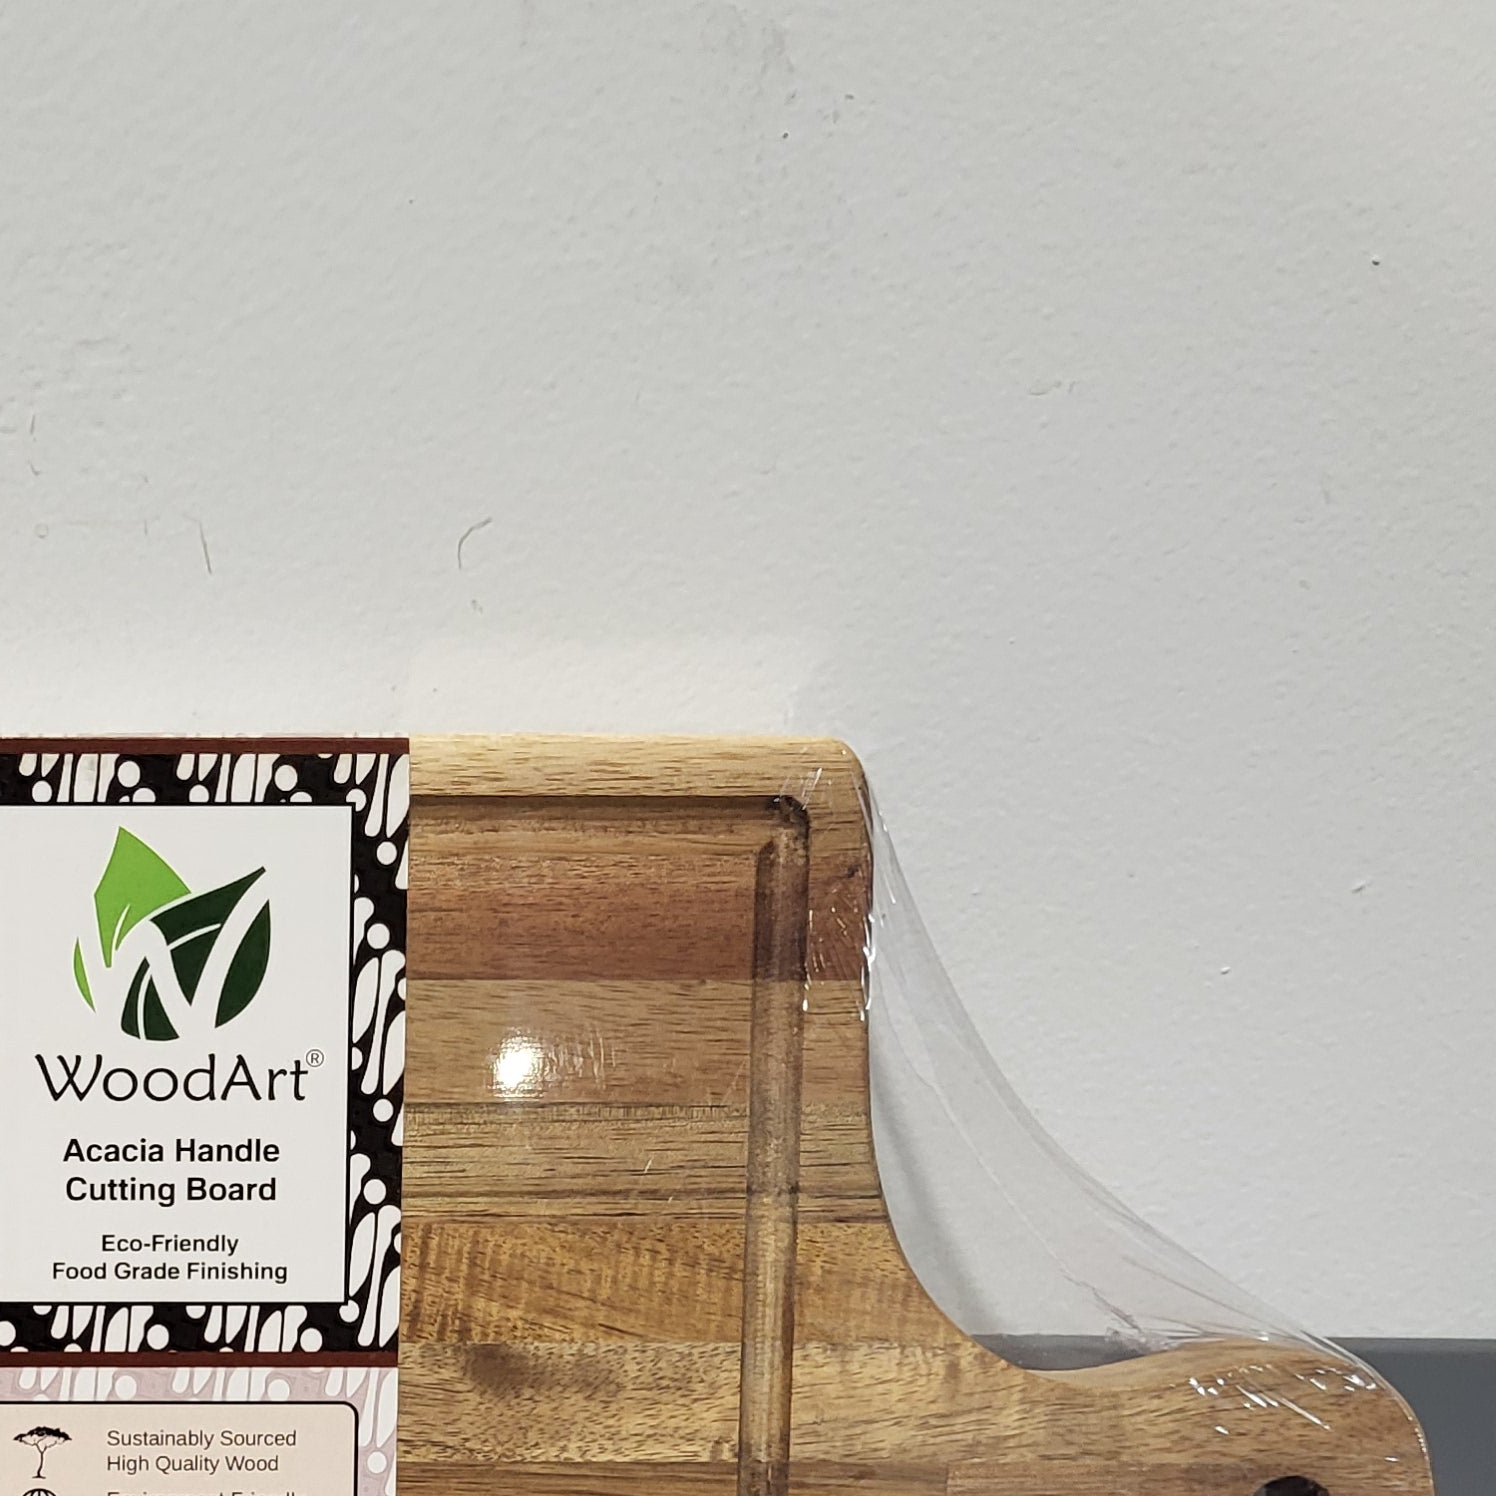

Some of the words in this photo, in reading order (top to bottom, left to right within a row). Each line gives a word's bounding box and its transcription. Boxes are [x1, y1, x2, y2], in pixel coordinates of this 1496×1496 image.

[62, 1137, 164, 1163] Acacia
[175, 1138, 280, 1163] Handle
[65, 1176, 176, 1208] Cutting
[186, 1176, 277, 1201] Board
[101, 1234, 239, 1257] Eco-Friendly
[52, 1261, 107, 1280] Food
[113, 1261, 181, 1280] Grade
[187, 1261, 288, 1285] Finishing
[106, 1429, 215, 1451] Sustainably
[219, 1429, 297, 1447] Sourced
[106, 1454, 150, 1476] High
[155, 1454, 221, 1476] Quality
[224, 1454, 279, 1472] Wood
